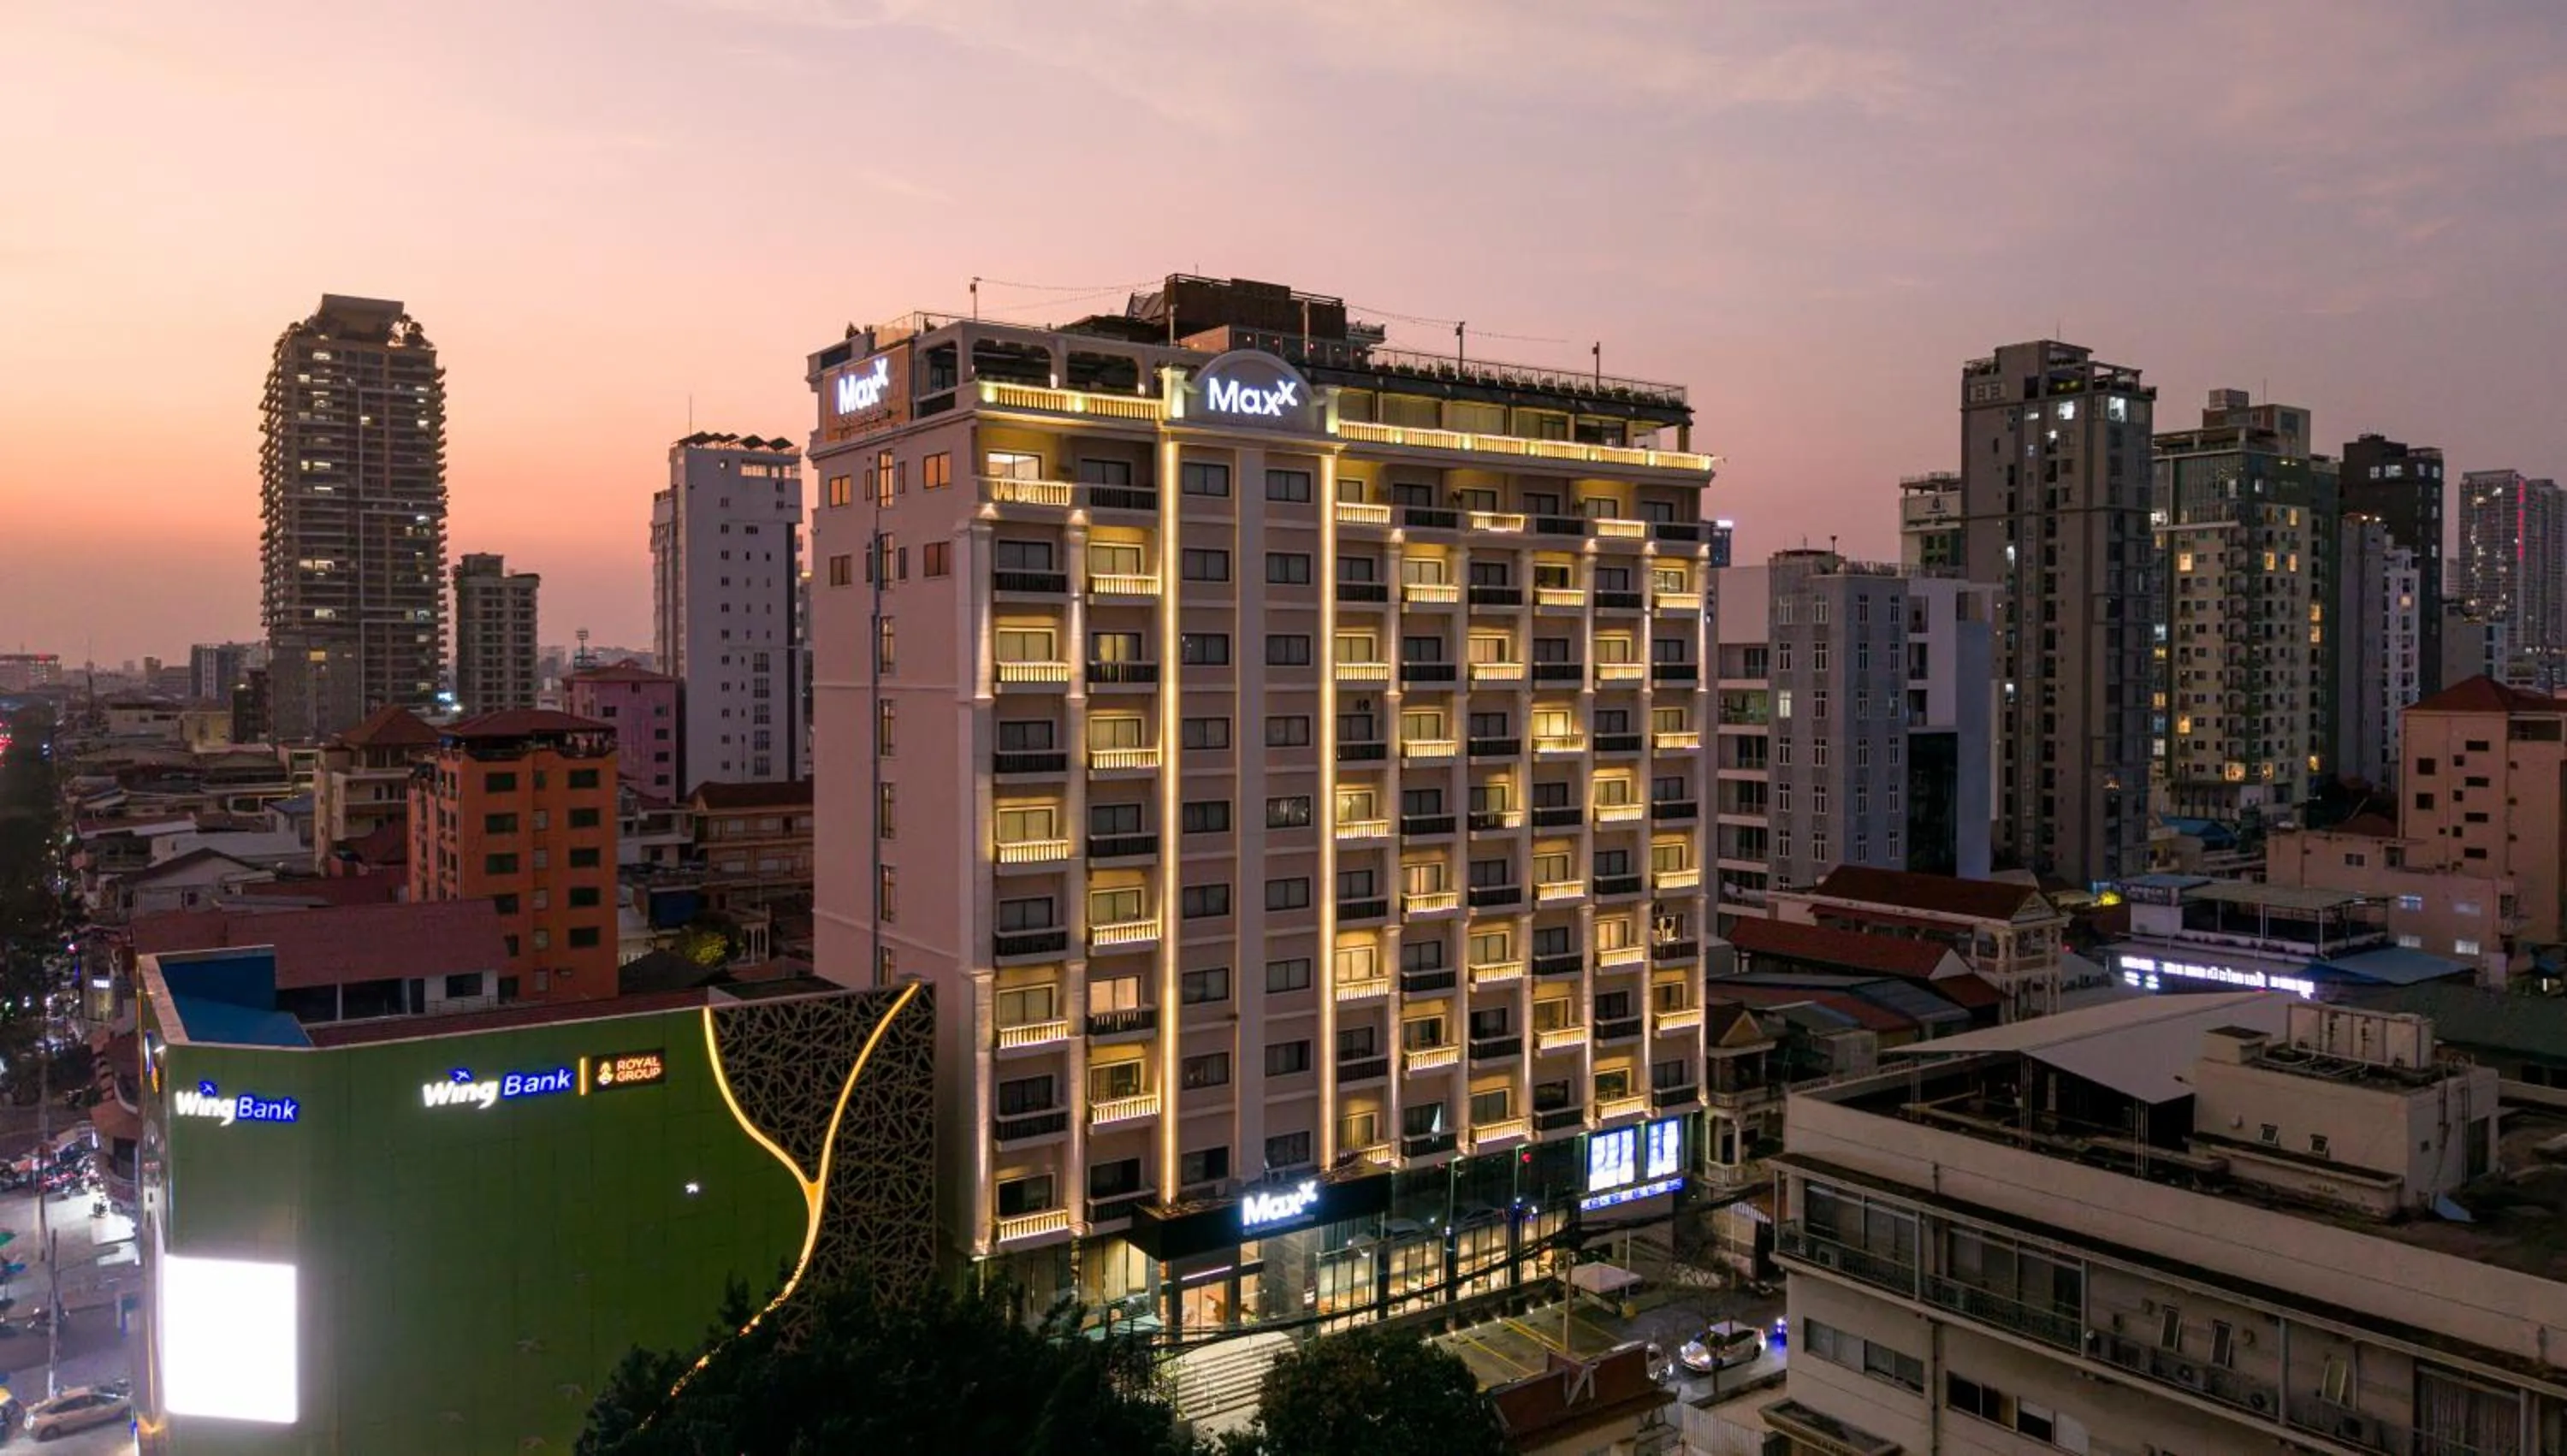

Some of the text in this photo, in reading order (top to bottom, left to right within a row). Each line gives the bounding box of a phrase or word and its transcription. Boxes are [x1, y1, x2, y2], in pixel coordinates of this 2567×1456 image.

[617, 1056, 661, 1070] ROYAL
[617, 1068, 661, 1082] GROUP
[423, 1068, 572, 1110] Wing Bank
[175, 1091, 296, 1127] Wing Bank
